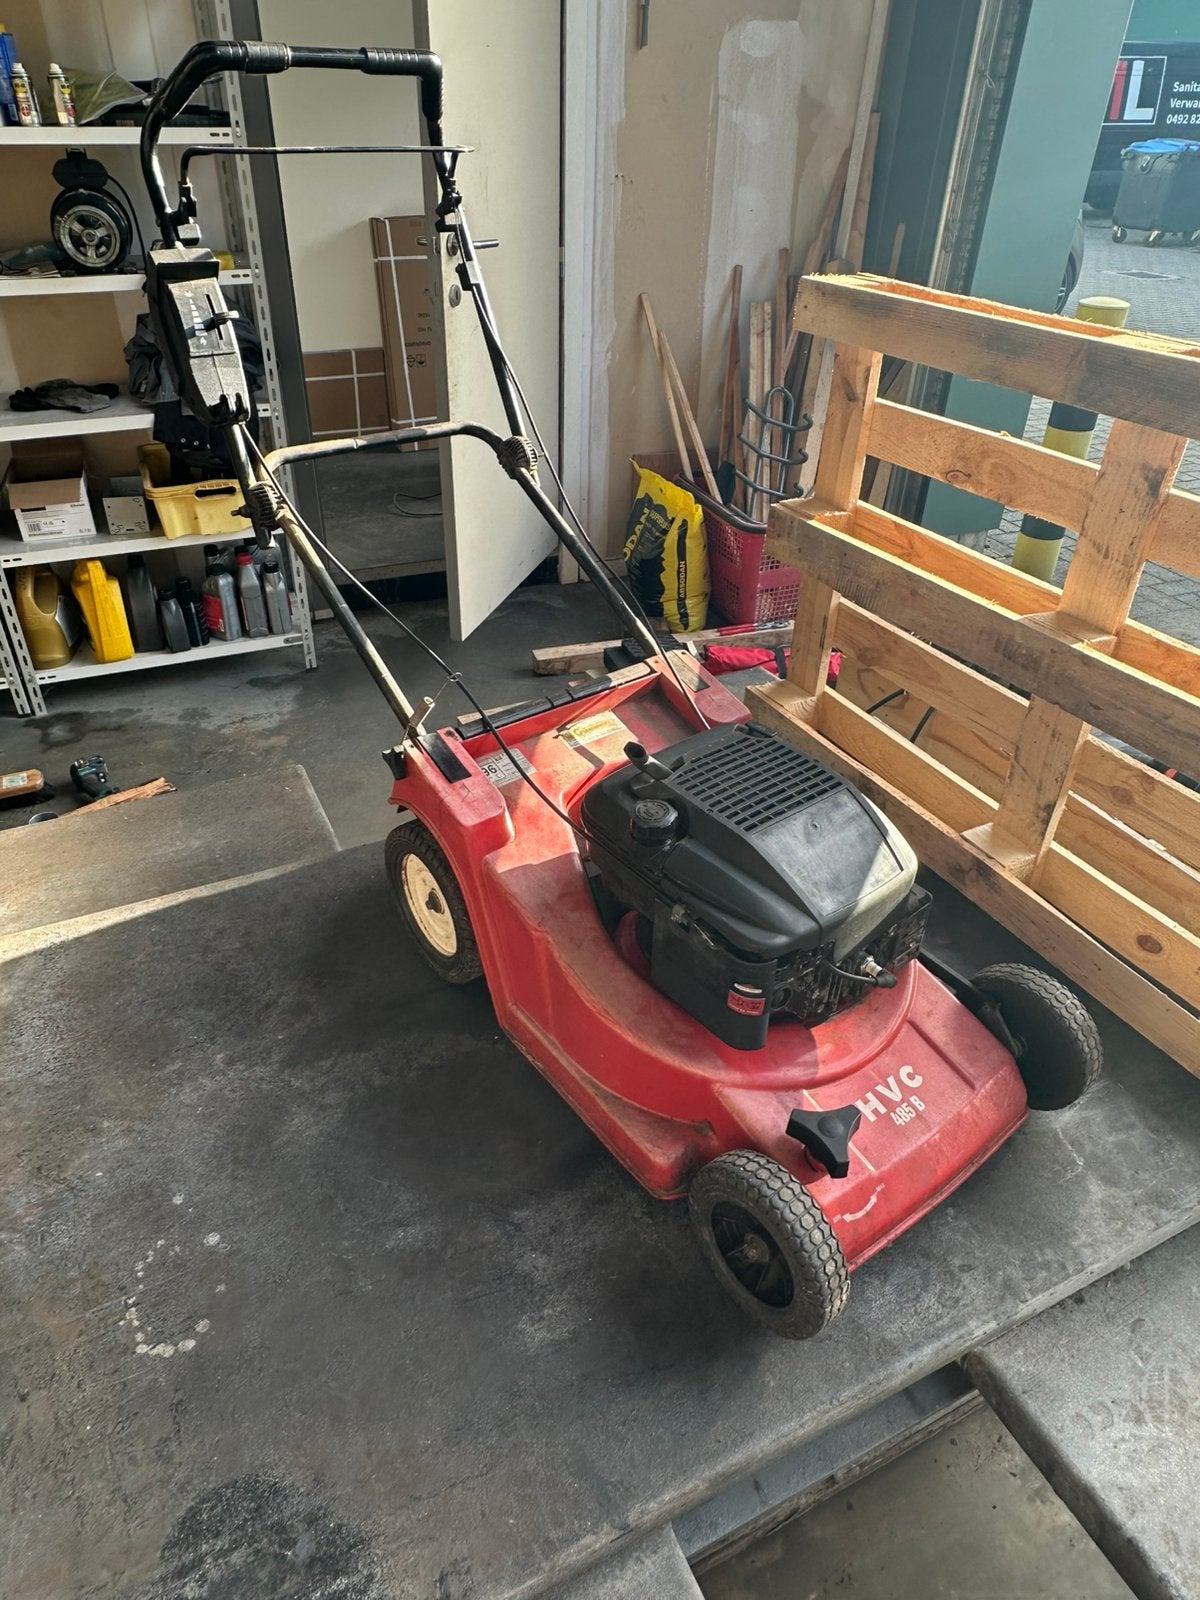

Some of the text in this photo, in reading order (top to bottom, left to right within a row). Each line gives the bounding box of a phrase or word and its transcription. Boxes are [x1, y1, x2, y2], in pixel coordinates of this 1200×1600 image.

[1166, 114, 1189, 124] 0492
[854, 1065, 923, 1122] HVC
[890, 1095, 926, 1126] 485 B
